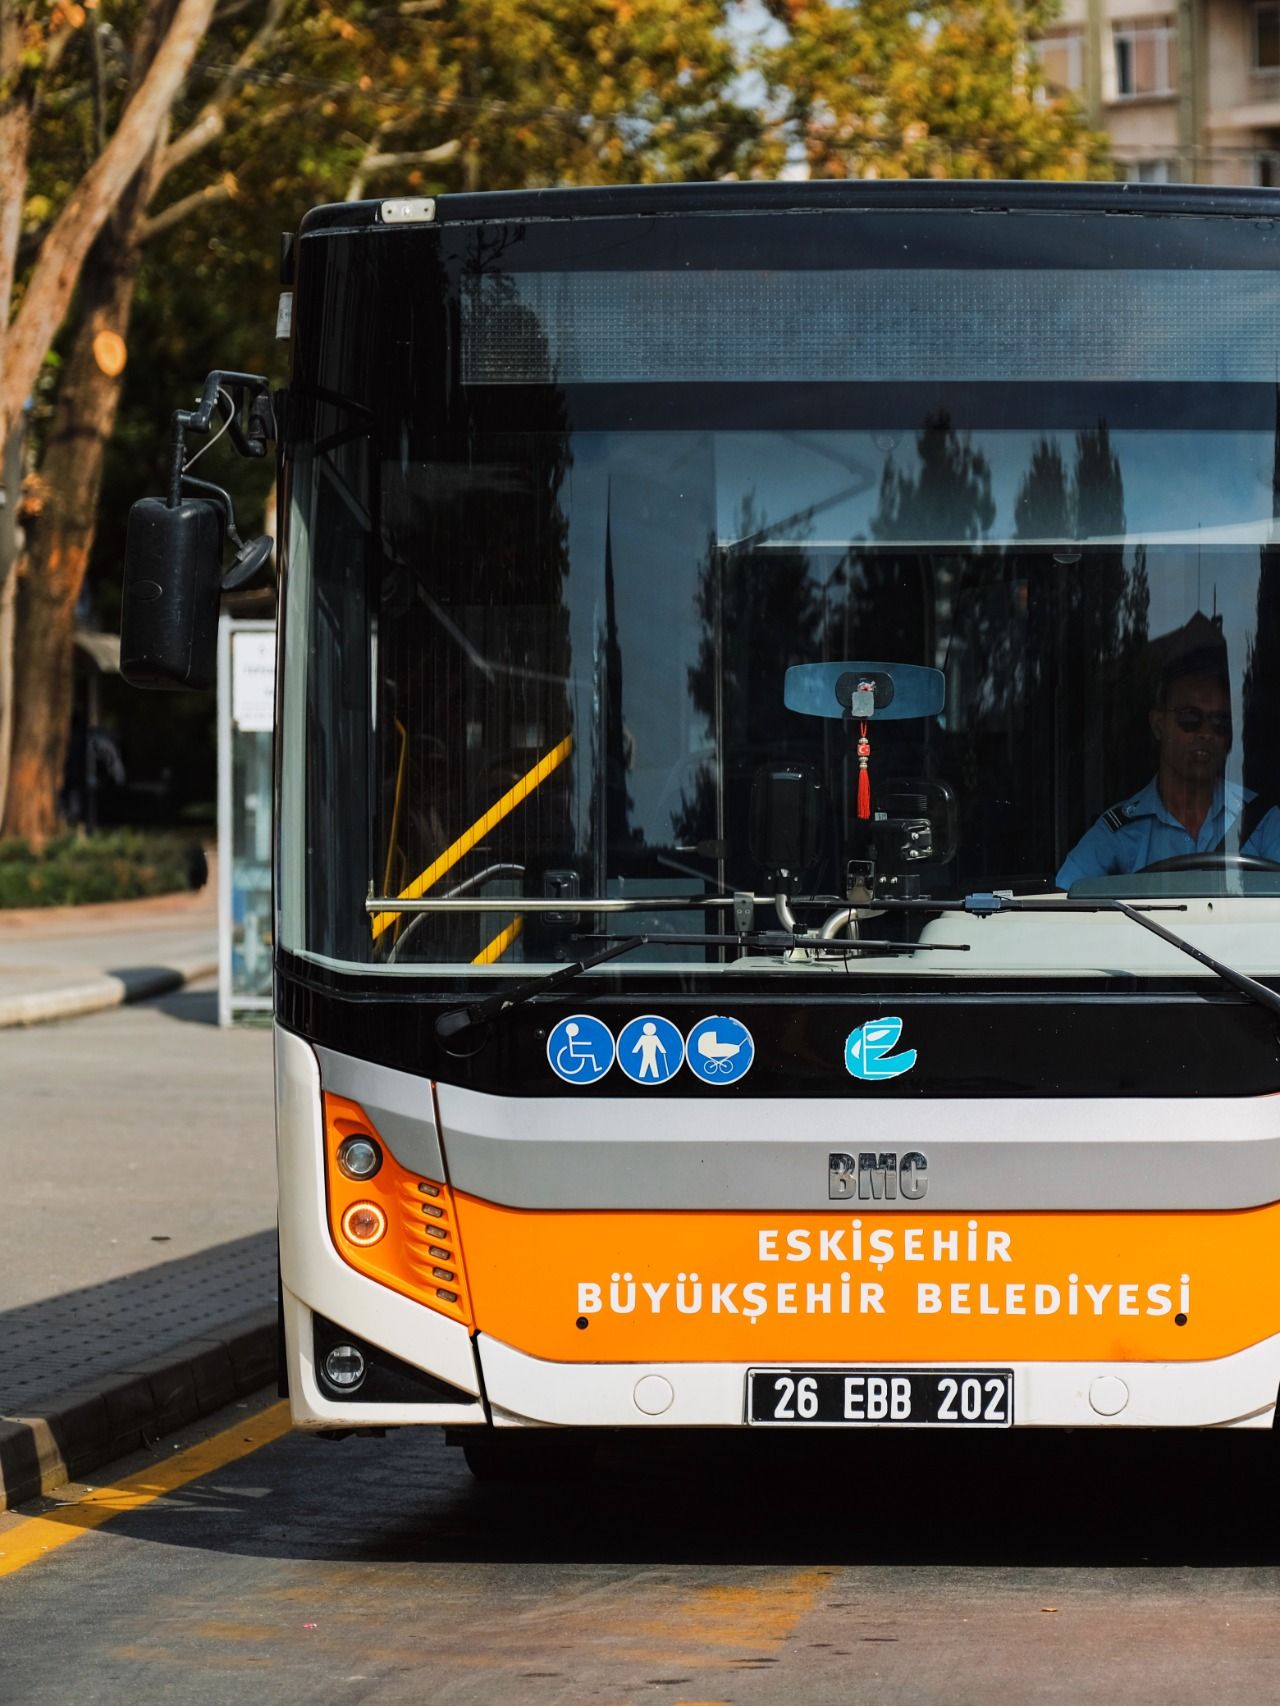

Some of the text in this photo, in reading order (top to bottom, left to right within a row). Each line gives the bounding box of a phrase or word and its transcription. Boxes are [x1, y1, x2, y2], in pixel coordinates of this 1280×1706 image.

[828, 1151, 929, 1200] BMC
[758, 1218, 1013, 1272] ESKİŞEHİR
[577, 1271, 1190, 1325] BÜYÜKŞEHİR BELEDİYESİ
[773, 1376, 1005, 1421] 26 EBB 202
